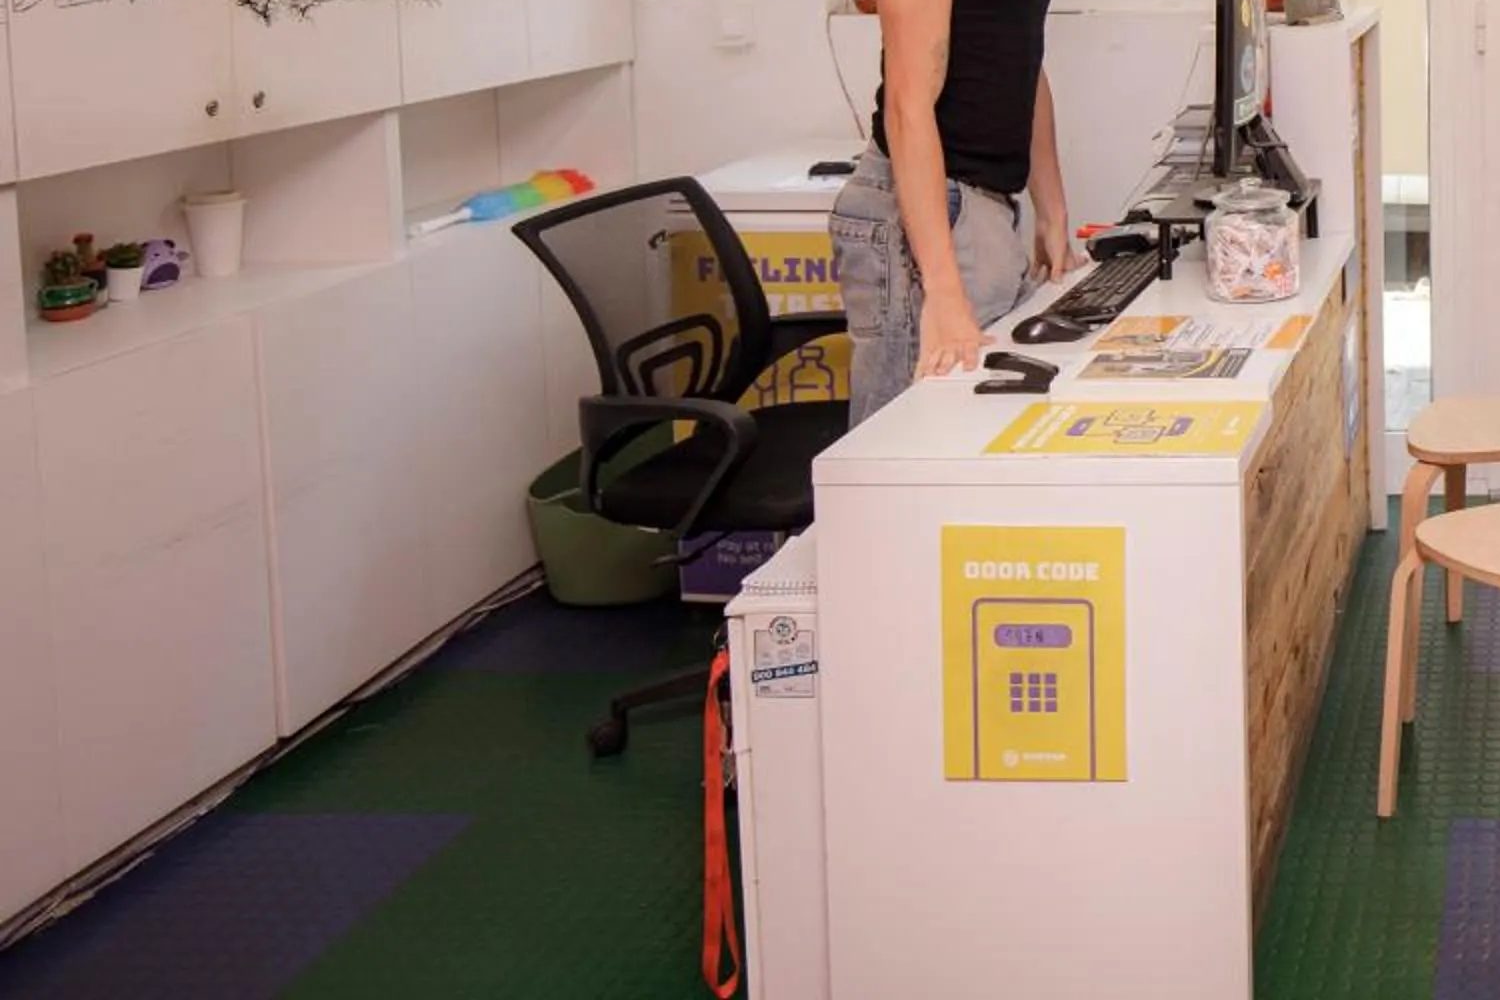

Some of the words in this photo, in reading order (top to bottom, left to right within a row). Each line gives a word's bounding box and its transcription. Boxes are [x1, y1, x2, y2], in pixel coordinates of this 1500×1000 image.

[697, 256, 842, 283] FLIN
[963, 560, 1031, 580] DOOR
[1036, 561, 1100, 582] CODE
